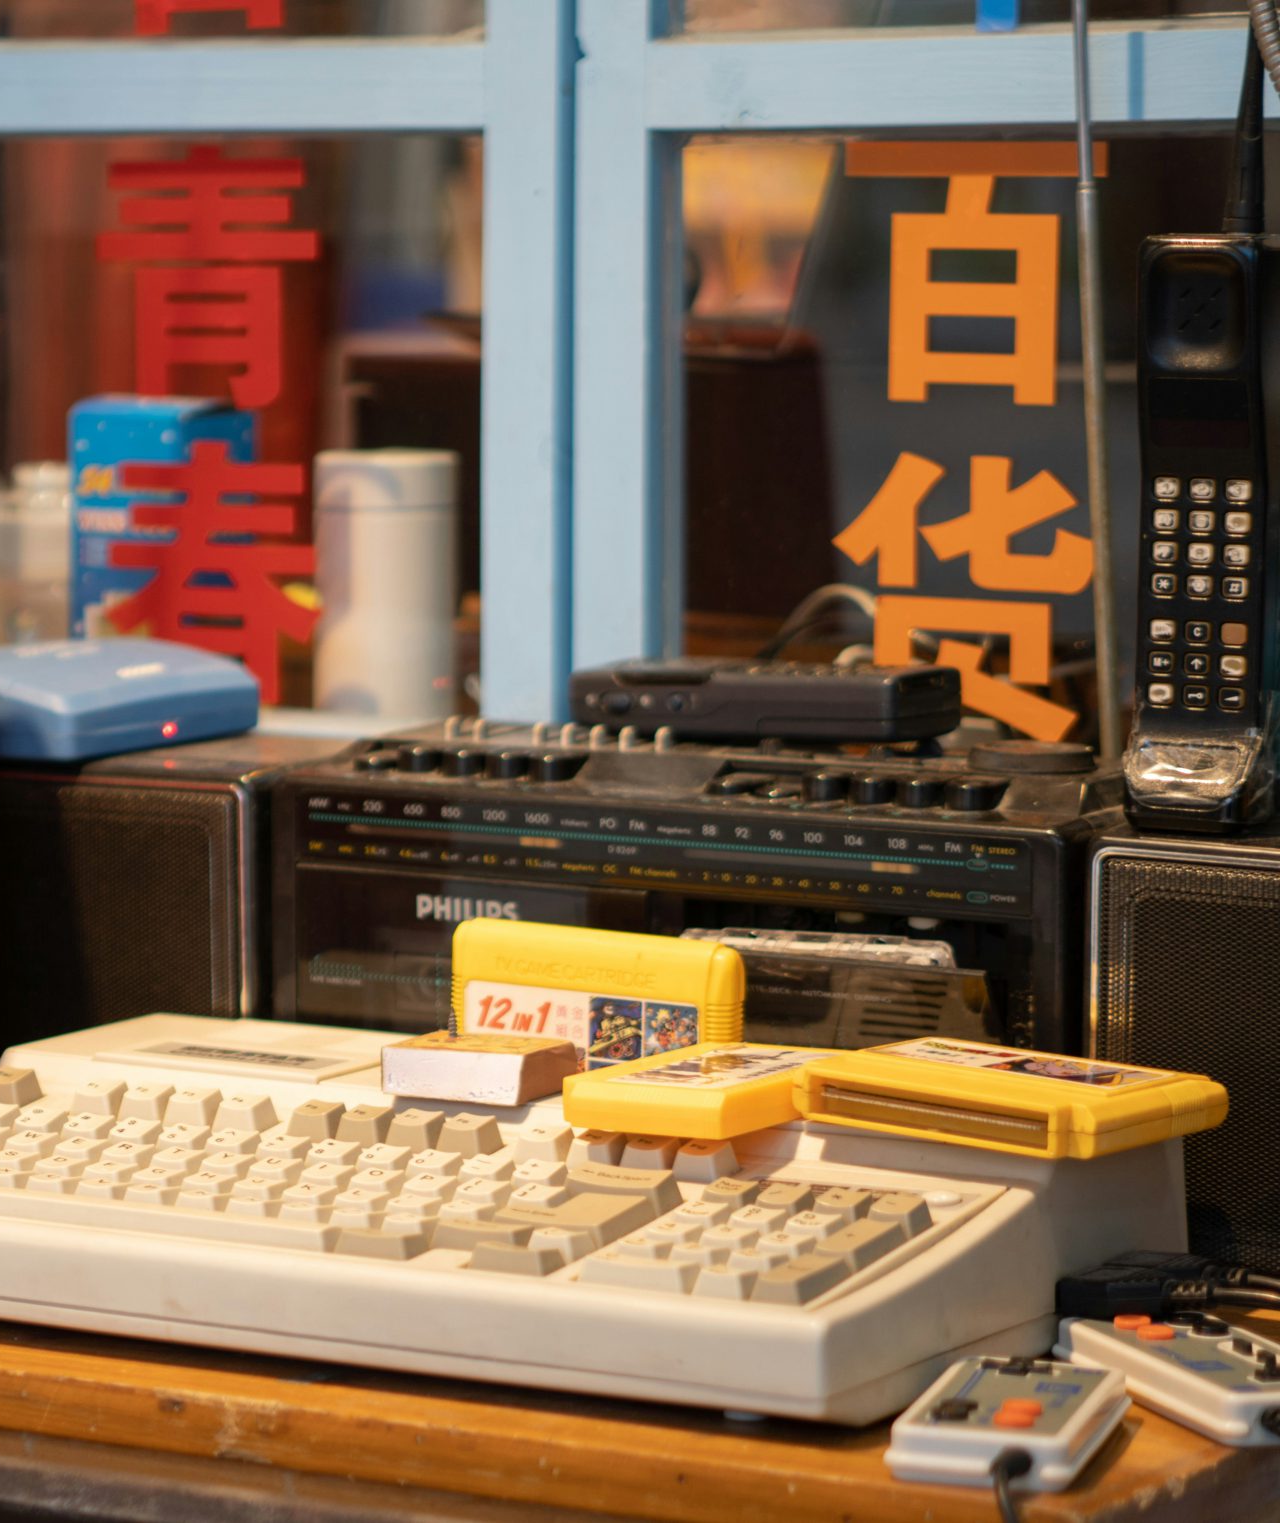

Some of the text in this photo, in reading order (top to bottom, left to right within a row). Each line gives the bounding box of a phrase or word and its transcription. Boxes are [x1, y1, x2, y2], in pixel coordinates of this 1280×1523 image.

[1193, 626, 1202, 637] C
[363, 801, 383, 813] 530
[403, 804, 424, 816] 650
[440, 806, 462, 818] 850
[482, 810, 507, 822] 1200
[525, 813, 550, 825] 1600
[600, 818, 616, 829] PO
[629, 819, 646, 831] FM
[702, 825, 718, 837] 88
[734, 827, 751, 839] 92
[769, 829, 785, 841] 96
[803, 832, 823, 844] 100
[844, 834, 864, 846] 104
[888, 837, 907, 849] 108
[945, 841, 961, 853] FM
[988, 847, 1016, 855] STEREO
[891, 885, 903, 895] 70
[416, 894, 518, 921] PHILIPS
[515, 960, 560, 979] GAME
[562, 964, 657, 989] CARTRIDGE
[478, 995, 551, 1034] 12 IN 1
